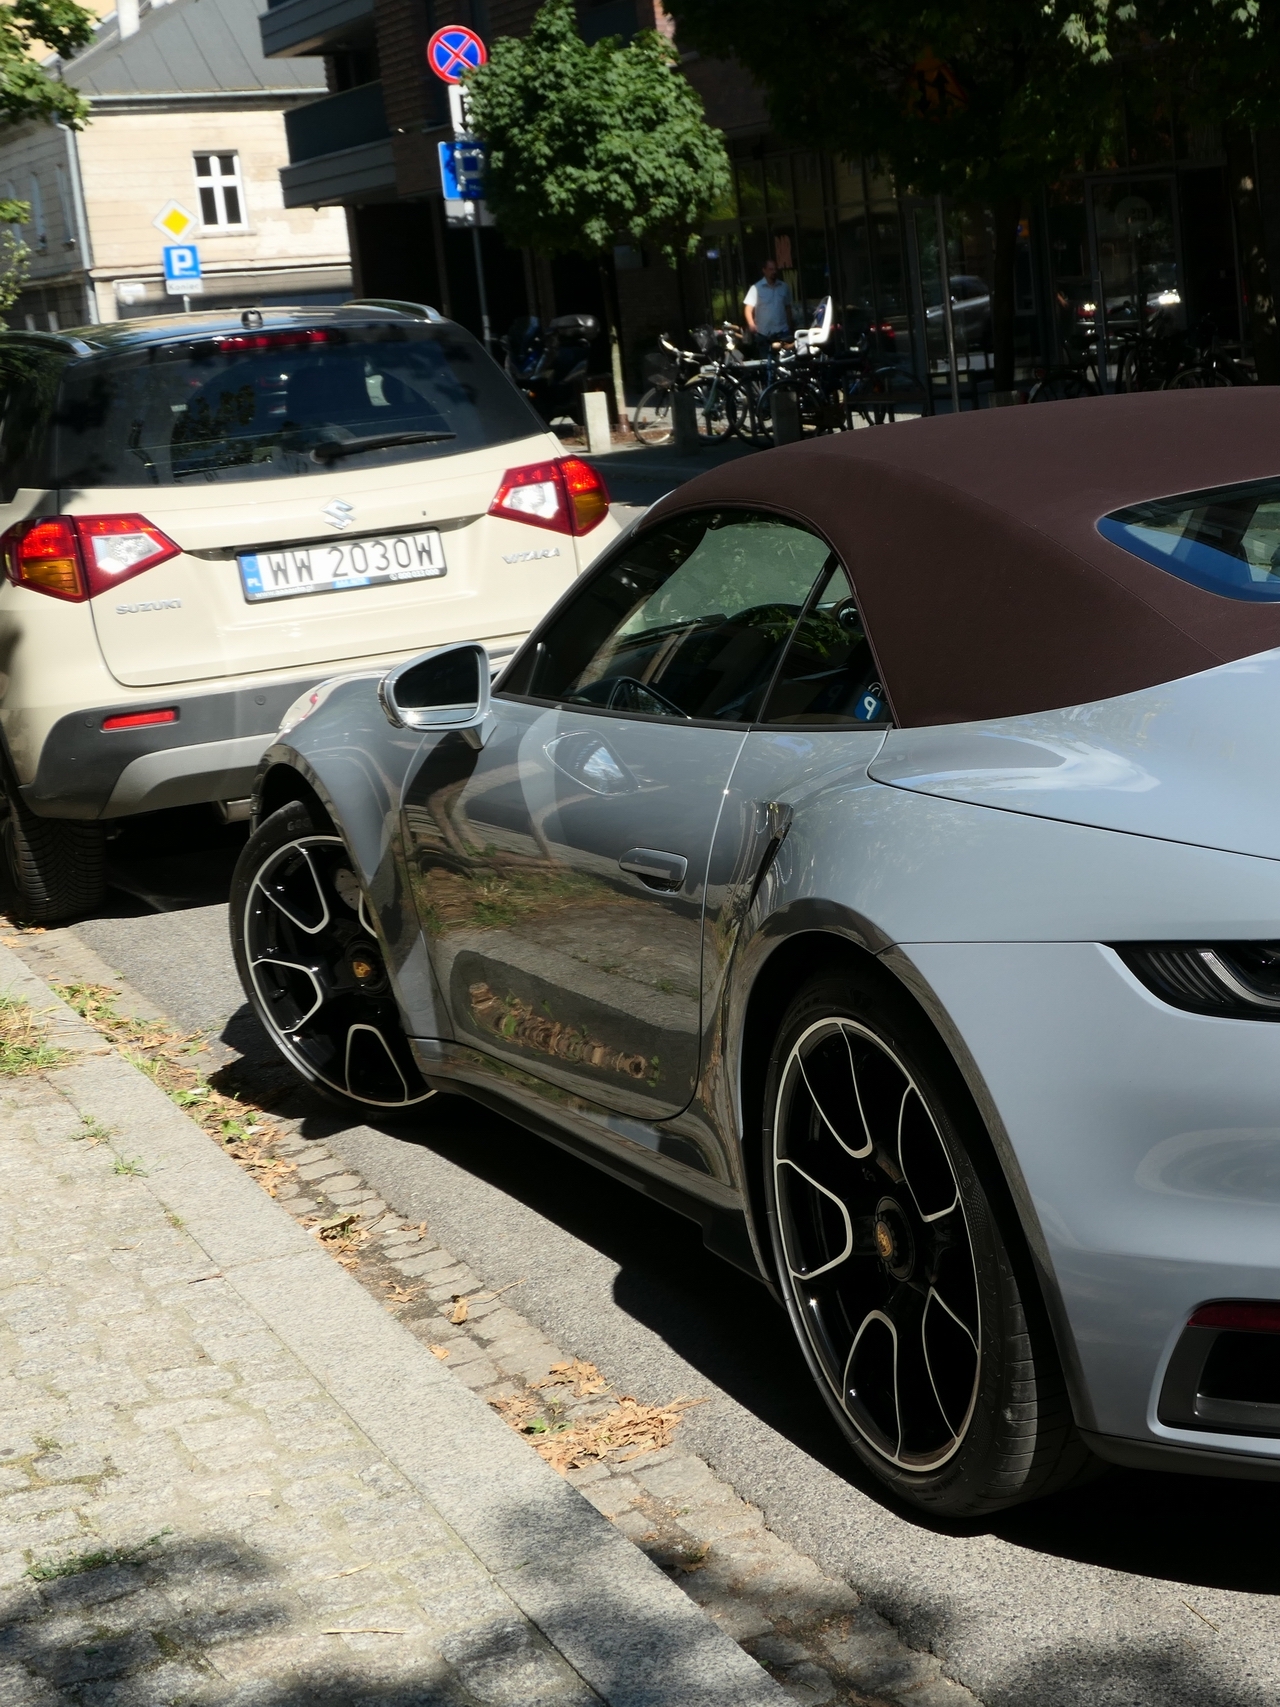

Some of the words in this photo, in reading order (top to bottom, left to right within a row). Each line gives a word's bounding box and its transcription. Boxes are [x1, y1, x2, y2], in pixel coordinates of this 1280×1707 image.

[169, 248, 195, 276] P
[168, 283, 200, 291] Koniec
[266, 549, 314, 586] WW
[327, 535, 434, 579] 2030W
[501, 547, 560, 564] VITARA
[247, 577, 262, 587] PL
[115, 598, 182, 615] SUZUKI
